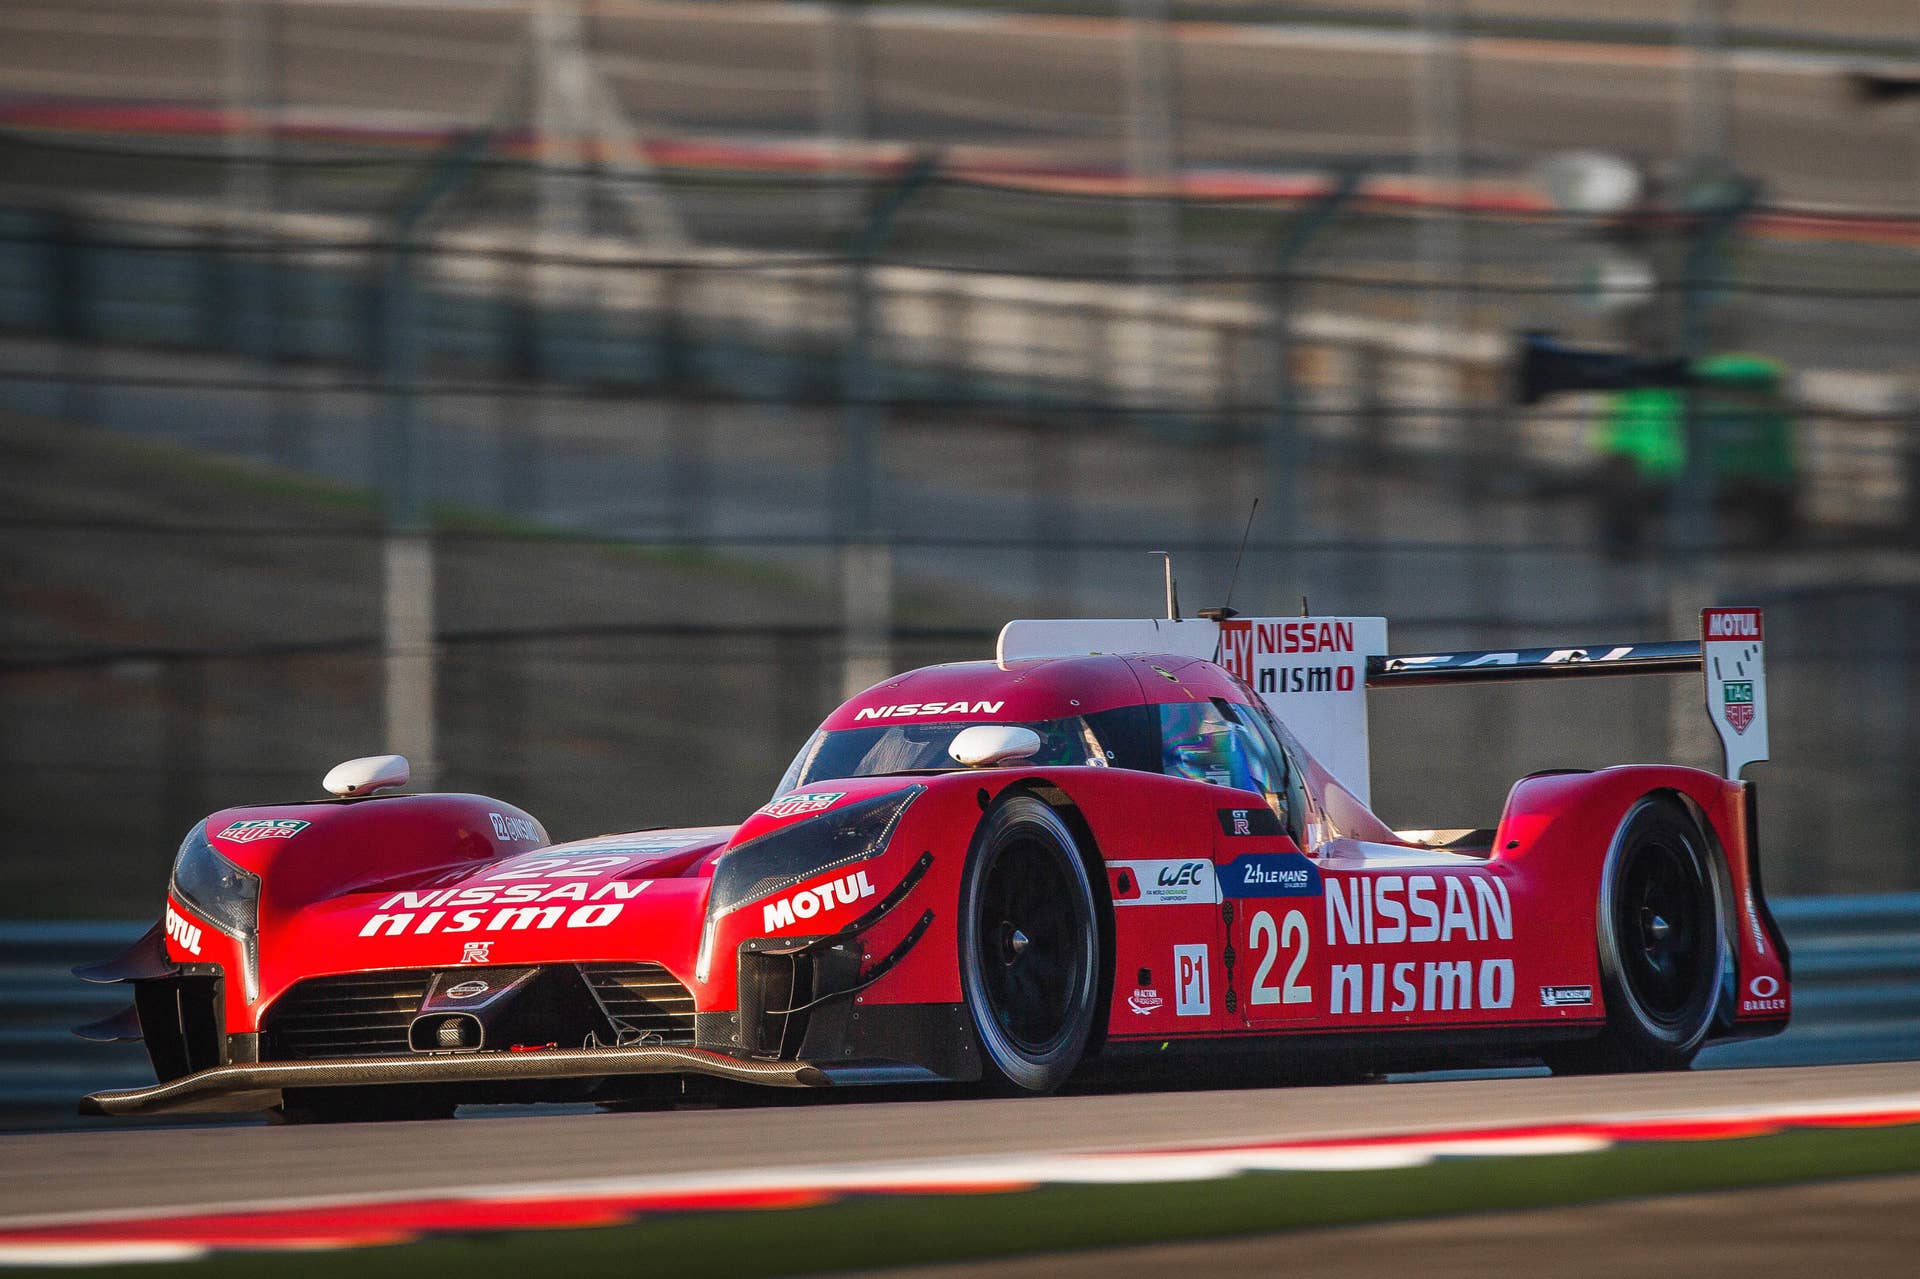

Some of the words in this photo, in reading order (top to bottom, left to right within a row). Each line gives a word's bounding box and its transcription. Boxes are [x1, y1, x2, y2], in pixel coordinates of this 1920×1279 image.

[1708, 613, 1759, 636] MOTUL
[1257, 622, 1353, 654] NISSAN
[1725, 684, 1752, 700] TAG
[854, 701, 1005, 720] NISSAN
[763, 801, 829, 815] HEUER
[1232, 810, 1249, 818] GT
[223, 828, 292, 840] HEUER
[237, 820, 302, 829] TAG
[1233, 819, 1251, 835] R
[484, 856, 630, 881] 22
[1157, 863, 1204, 886] WEC
[1265, 871, 1279, 883] LE
[1279, 870, 1308, 882] MANS
[378, 880, 654, 911] NISSAN
[763, 870, 875, 934] MOTUL
[1324, 875, 1513, 945] NISSAN
[464, 941, 495, 949] GT
[1249, 909, 1312, 1005] 22
[1180, 955, 1205, 1005] P1
